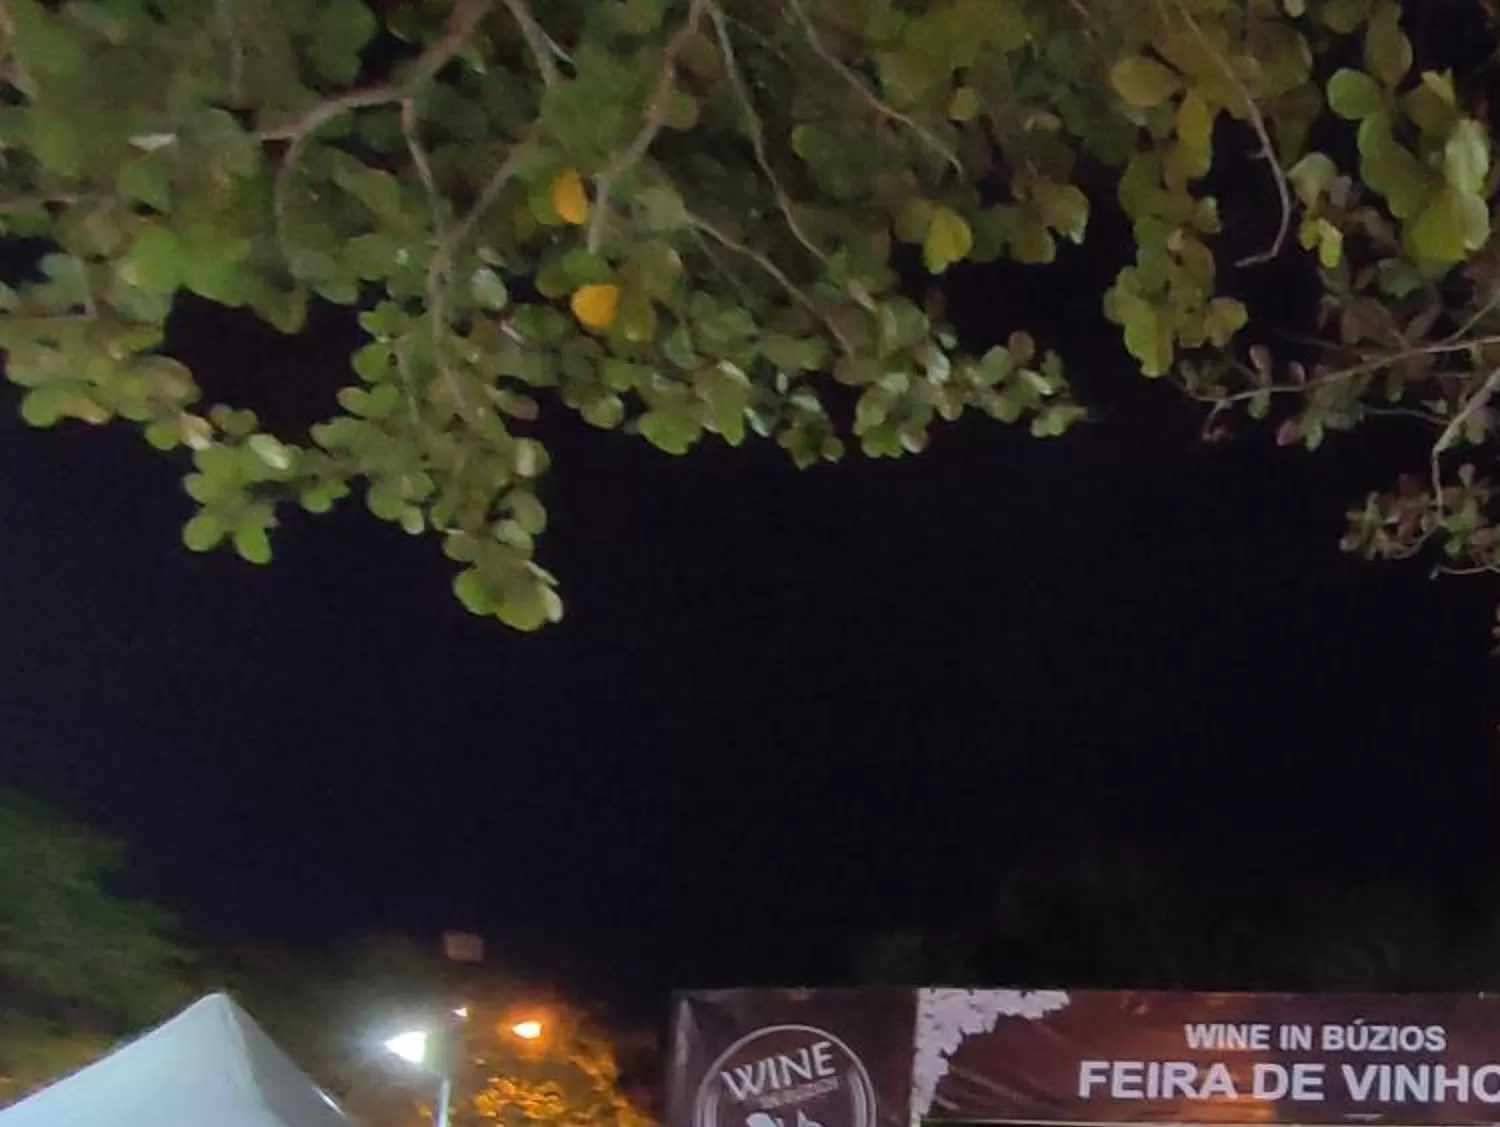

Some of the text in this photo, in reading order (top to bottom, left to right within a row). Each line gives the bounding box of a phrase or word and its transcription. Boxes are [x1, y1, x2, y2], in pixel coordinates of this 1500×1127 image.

[1184, 1017, 1448, 1052] WINE IN BÚZIOS
[719, 1040, 837, 1101] WINE
[1077, 1060, 1240, 1100] FEIRA
[1252, 1062, 1327, 1101] DE
